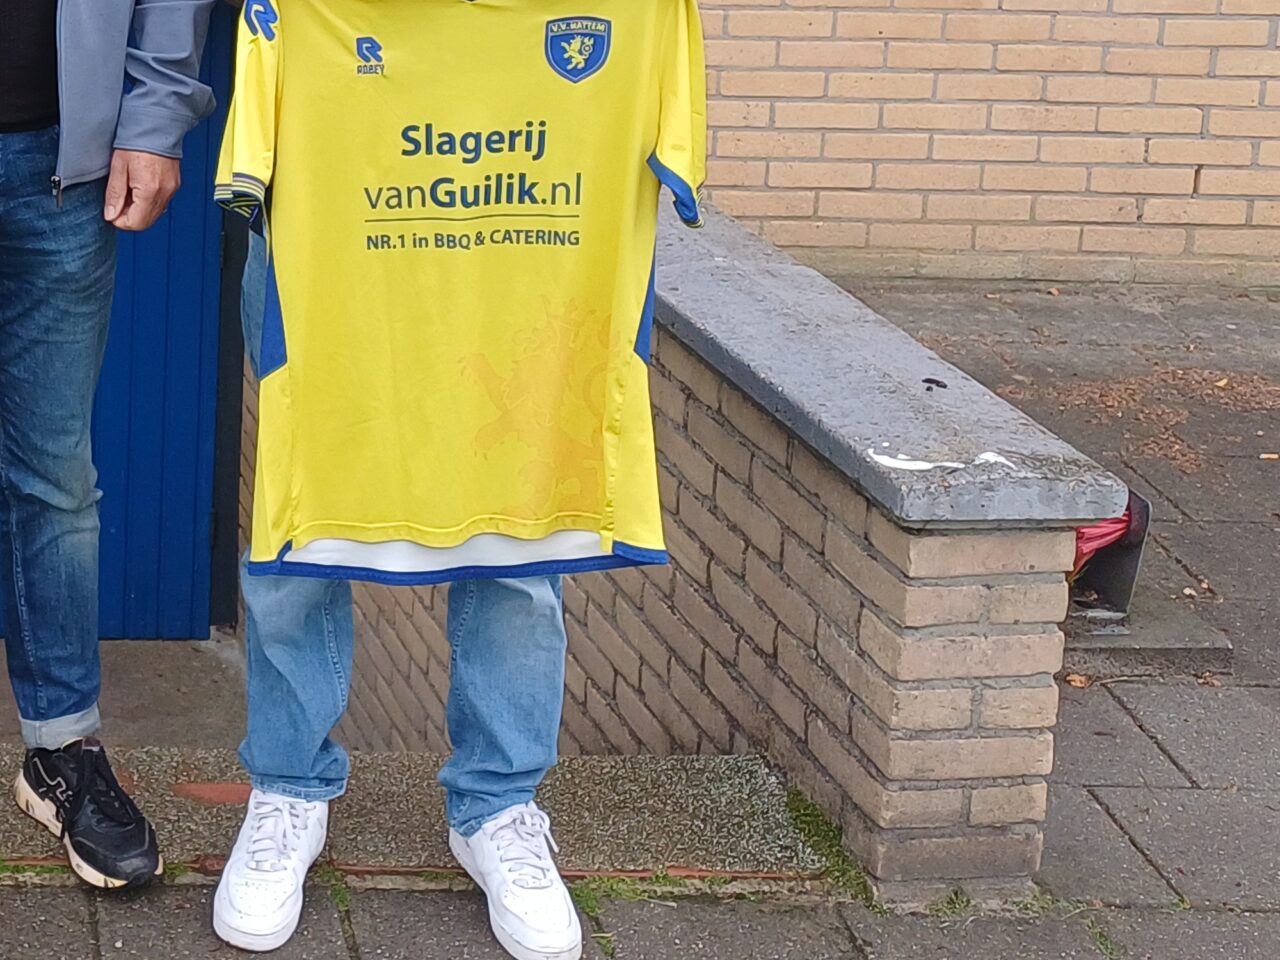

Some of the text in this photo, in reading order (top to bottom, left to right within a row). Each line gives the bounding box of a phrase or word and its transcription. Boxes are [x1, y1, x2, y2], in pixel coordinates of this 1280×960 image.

[400, 119, 548, 165] Slagerij
[363, 172, 582, 210] vanGuilik.nl
[366, 228, 581, 251] NR.1 in BBQ & CATERING
